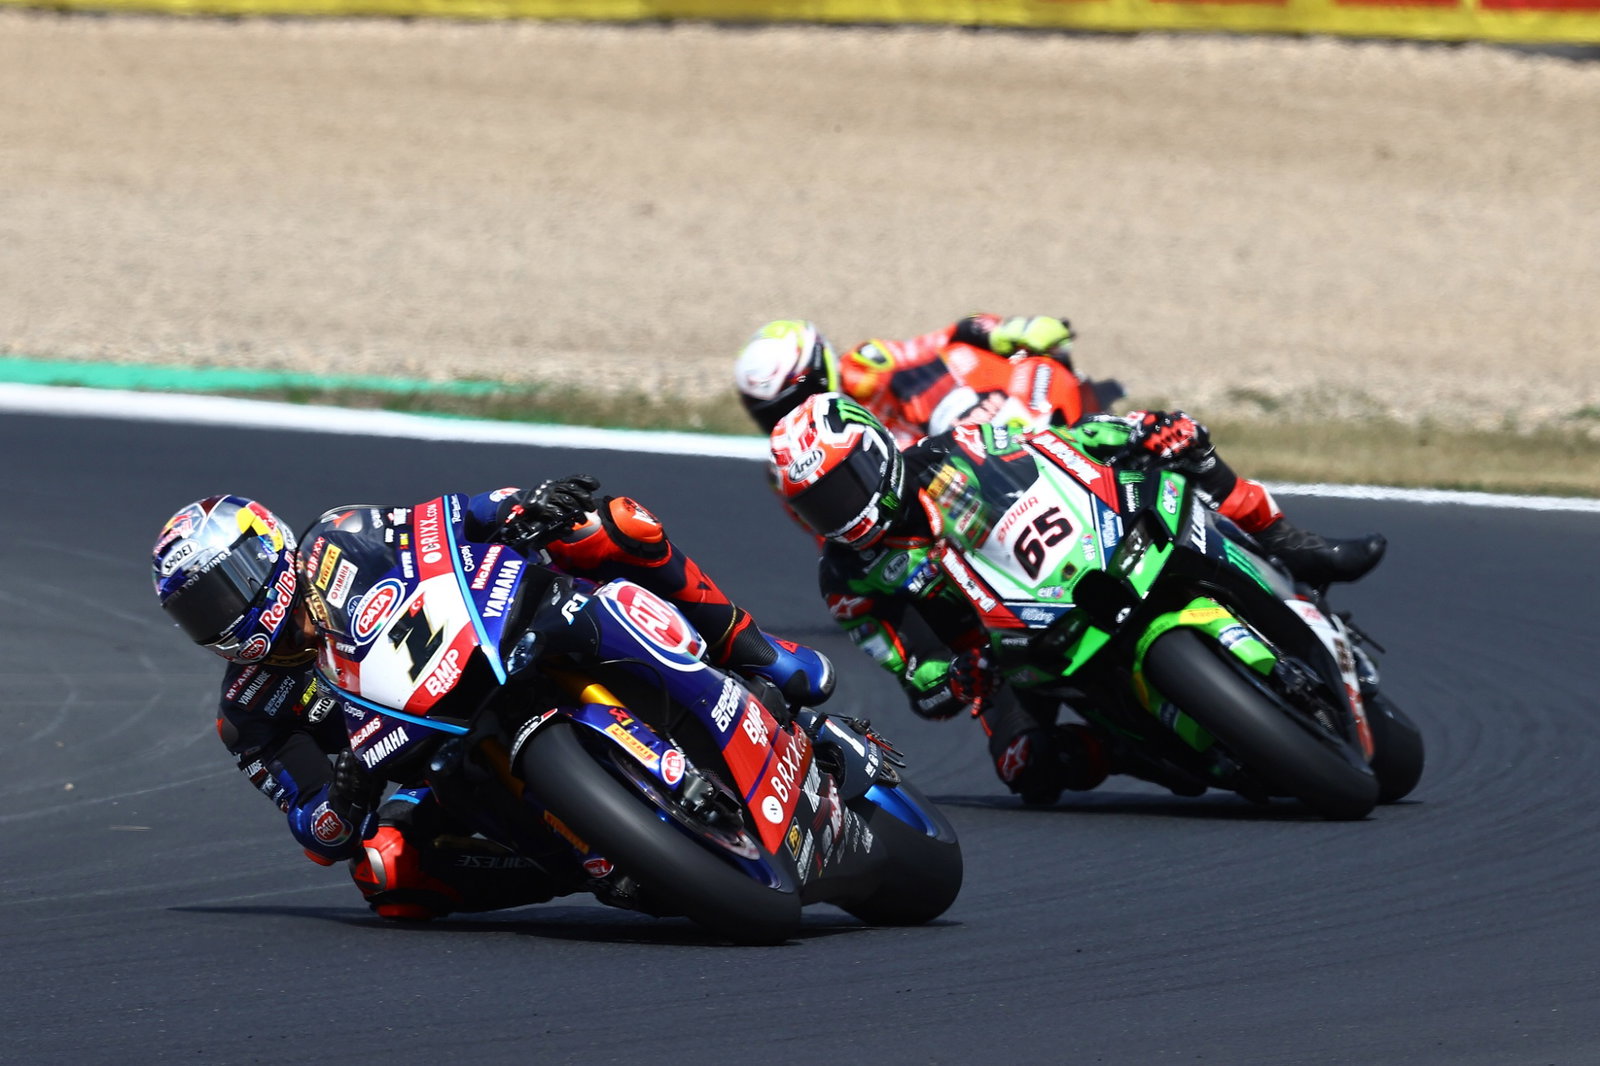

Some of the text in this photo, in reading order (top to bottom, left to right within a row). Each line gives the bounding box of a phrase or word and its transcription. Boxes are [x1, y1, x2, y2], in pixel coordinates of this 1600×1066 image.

[792, 452, 819, 476] Arai
[997, 496, 1039, 543] SHOWA
[163, 545, 194, 572] SHOEI
[460, 545, 475, 572] Corpay
[1013, 507, 1074, 581] 65
[200, 550, 232, 575] WINGS
[472, 545, 502, 589] McAMS
[333, 564, 350, 598] YAMAHA
[483, 560, 523, 618] YAMAHA
[358, 592, 391, 630] PATA
[561, 593, 589, 625] R1
[387, 602, 446, 685] 1
[238, 671, 272, 706] YAMALUBE
[425, 649, 460, 697] BMP
[312, 694, 332, 720] SHO
[343, 702, 367, 721] Corpay
[742, 701, 761, 745] BMP
[351, 717, 381, 749] McAMS
[362, 726, 409, 769] YAMAHA
[317, 813, 339, 840] PATA
